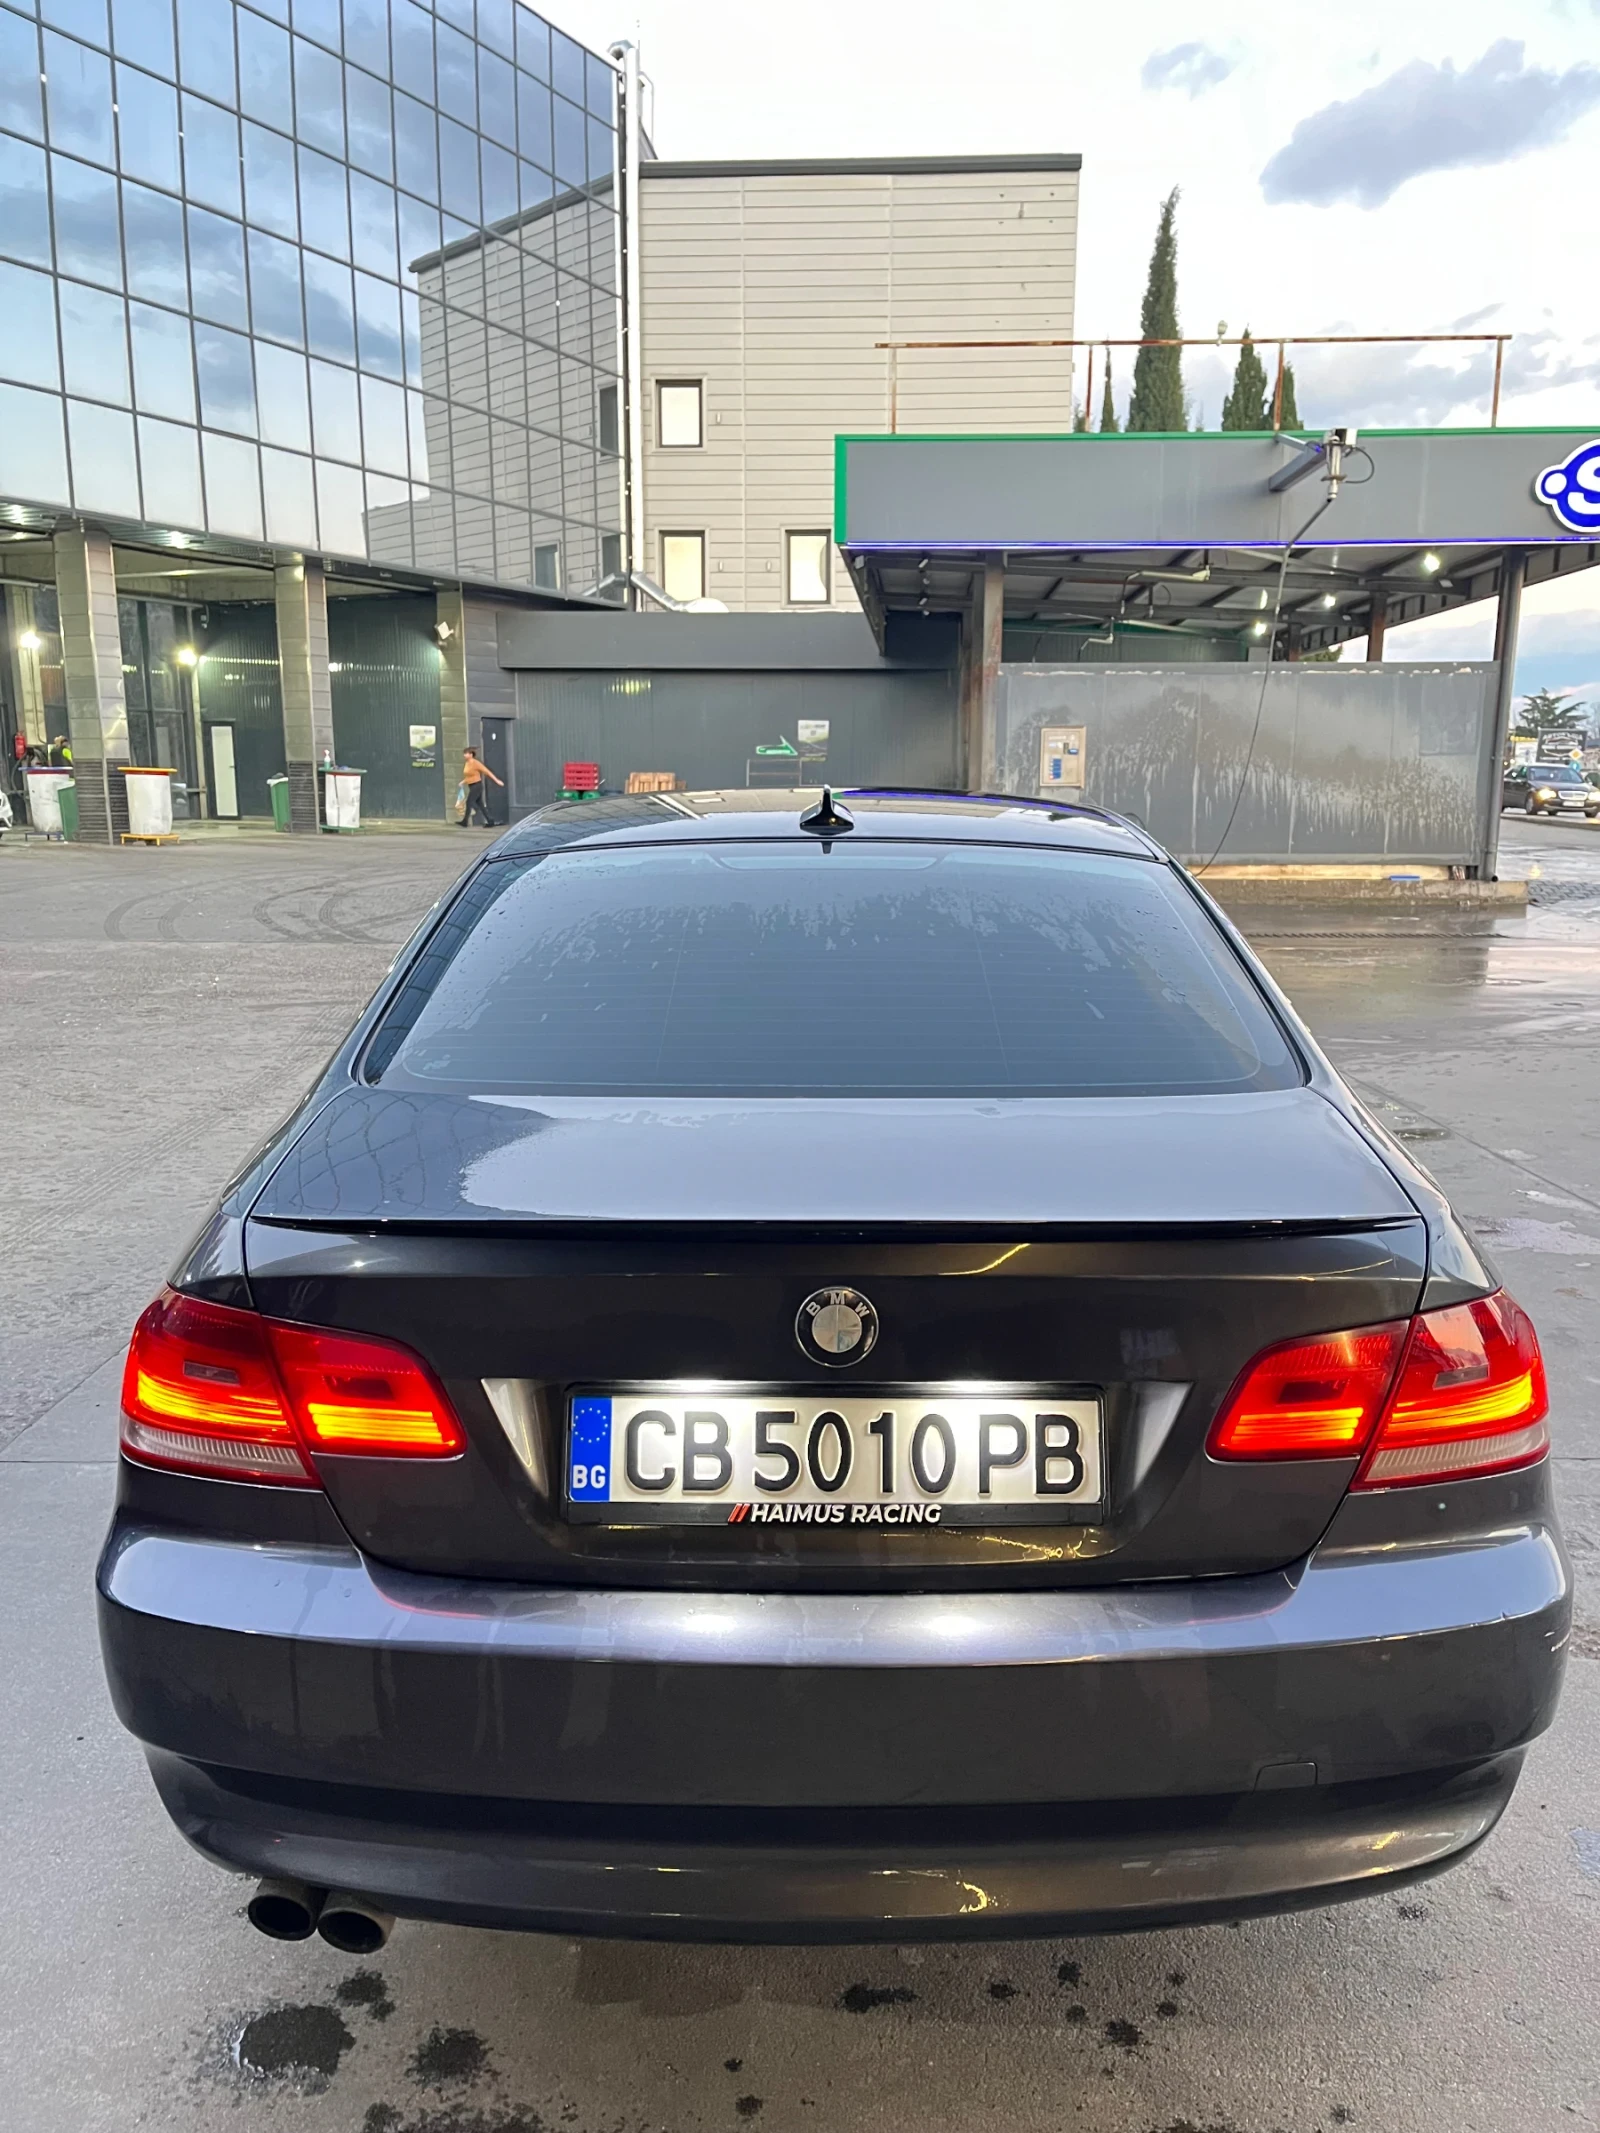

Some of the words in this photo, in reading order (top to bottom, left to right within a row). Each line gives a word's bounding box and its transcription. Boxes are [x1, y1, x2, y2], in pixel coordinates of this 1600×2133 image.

[805, 1290, 870, 1318] BMW
[625, 1410, 733, 1493] CB
[754, 1410, 957, 1495] 5010
[979, 1413, 1084, 1496] PB
[572, 1464, 607, 1490] BG
[750, 1503, 846, 1524] HAIMUS
[850, 1504, 942, 1525] RACING
